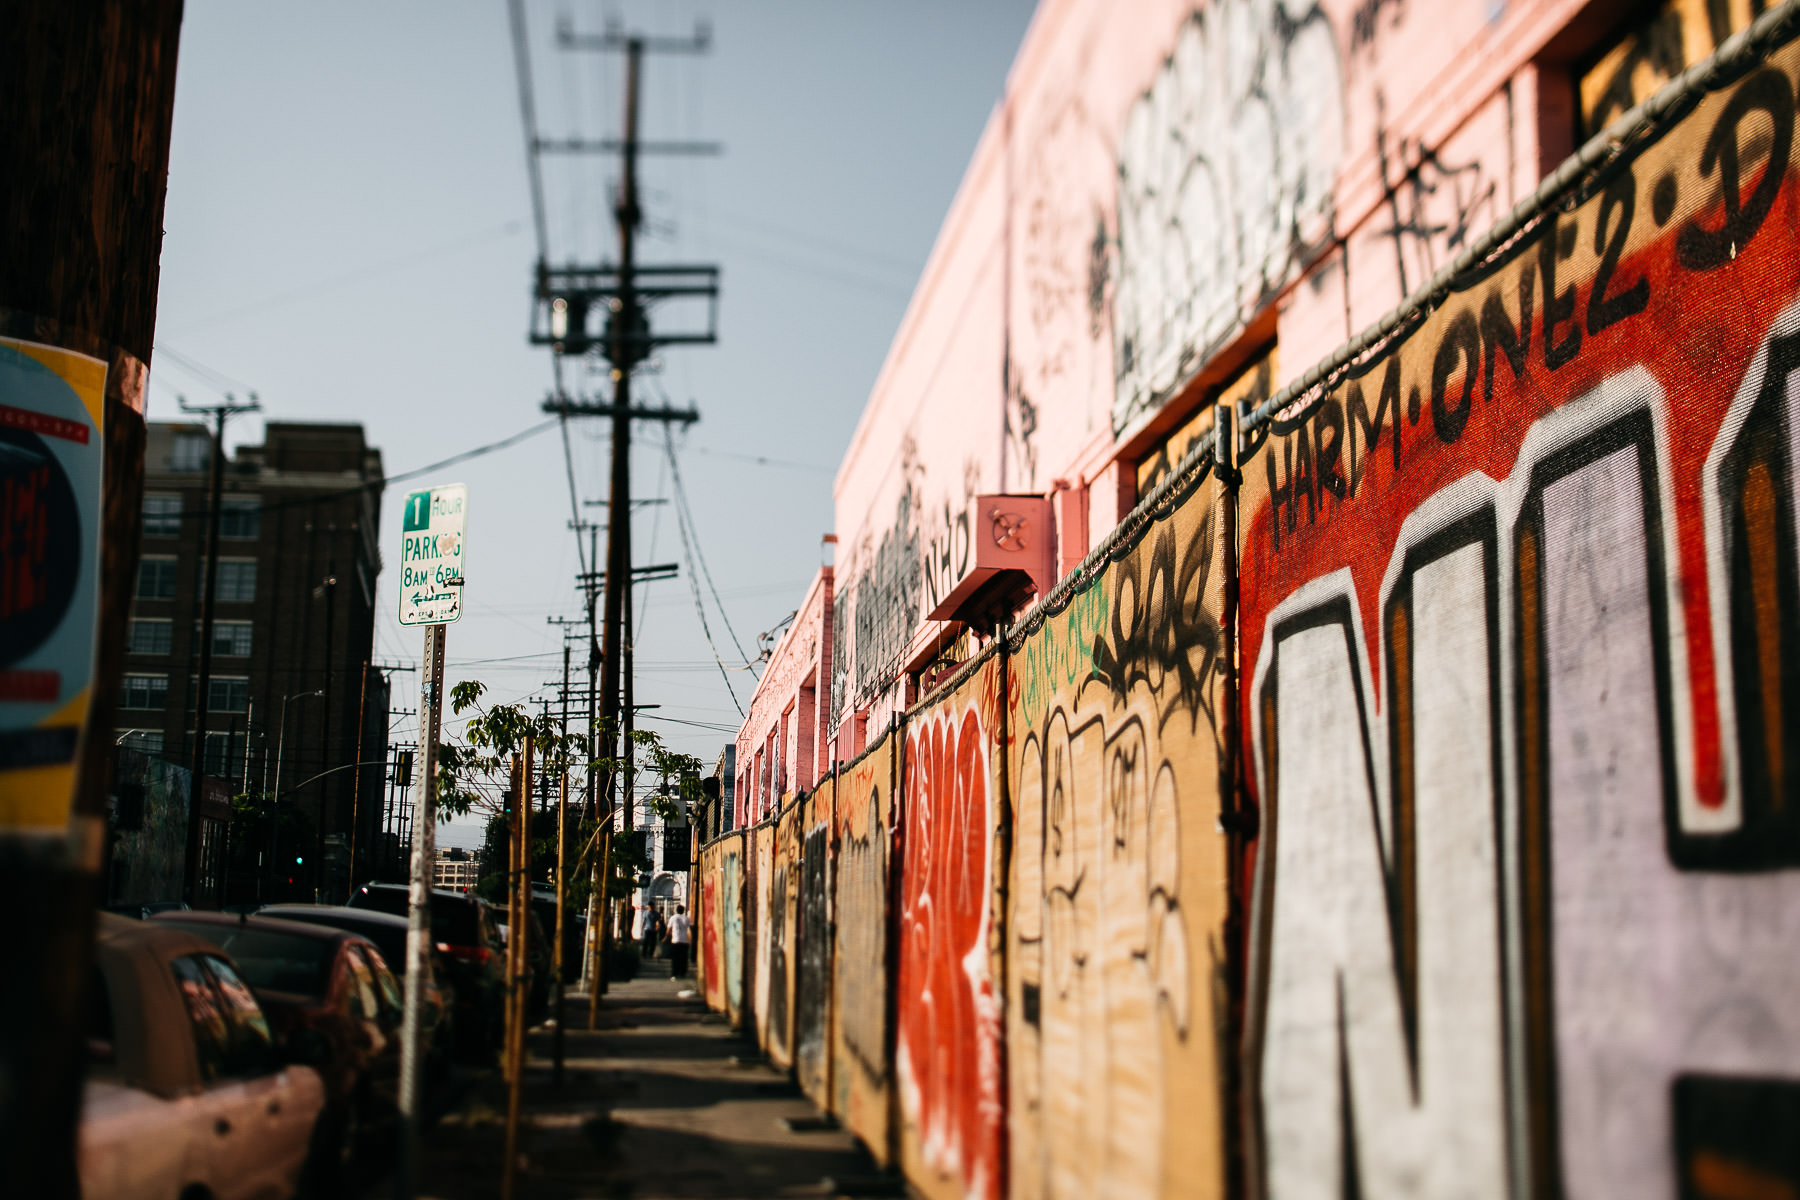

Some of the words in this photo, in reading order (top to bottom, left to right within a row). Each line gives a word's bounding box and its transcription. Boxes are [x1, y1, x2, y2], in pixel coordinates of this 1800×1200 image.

[413, 496, 422, 526] 1
[432, 497, 463, 517] HOUR
[404, 531, 461, 562] PARK
[403, 567, 428, 588] 8AM
[435, 564, 459, 584] 6PM
